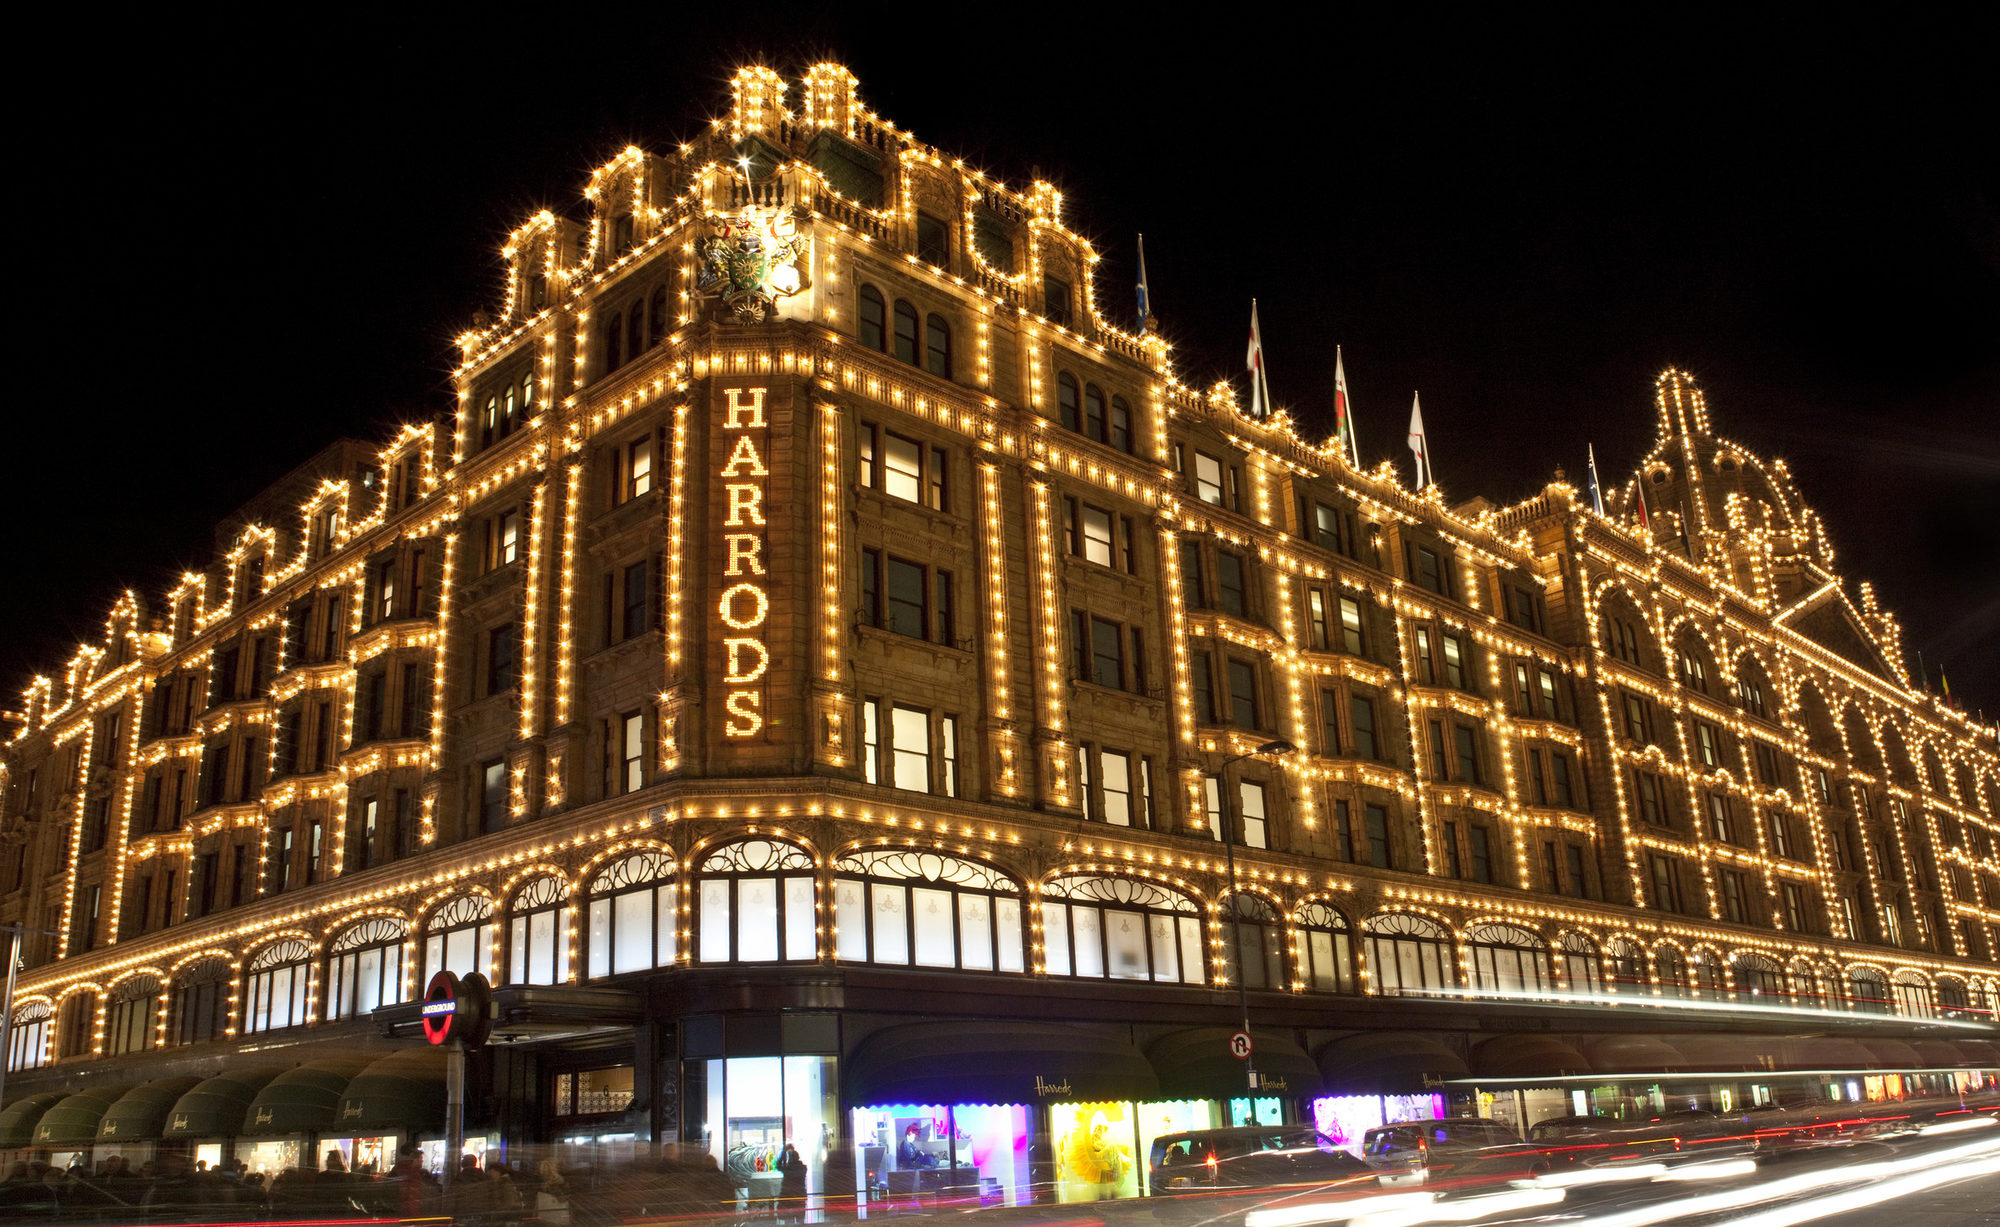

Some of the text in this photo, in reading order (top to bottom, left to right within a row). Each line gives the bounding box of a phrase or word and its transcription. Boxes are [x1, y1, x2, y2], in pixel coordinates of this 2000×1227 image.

[719, 387, 769, 737] HARRODS
[422, 1002, 455, 1014] UNDERGROUND
[1033, 1075, 1073, 1096] Harrods
